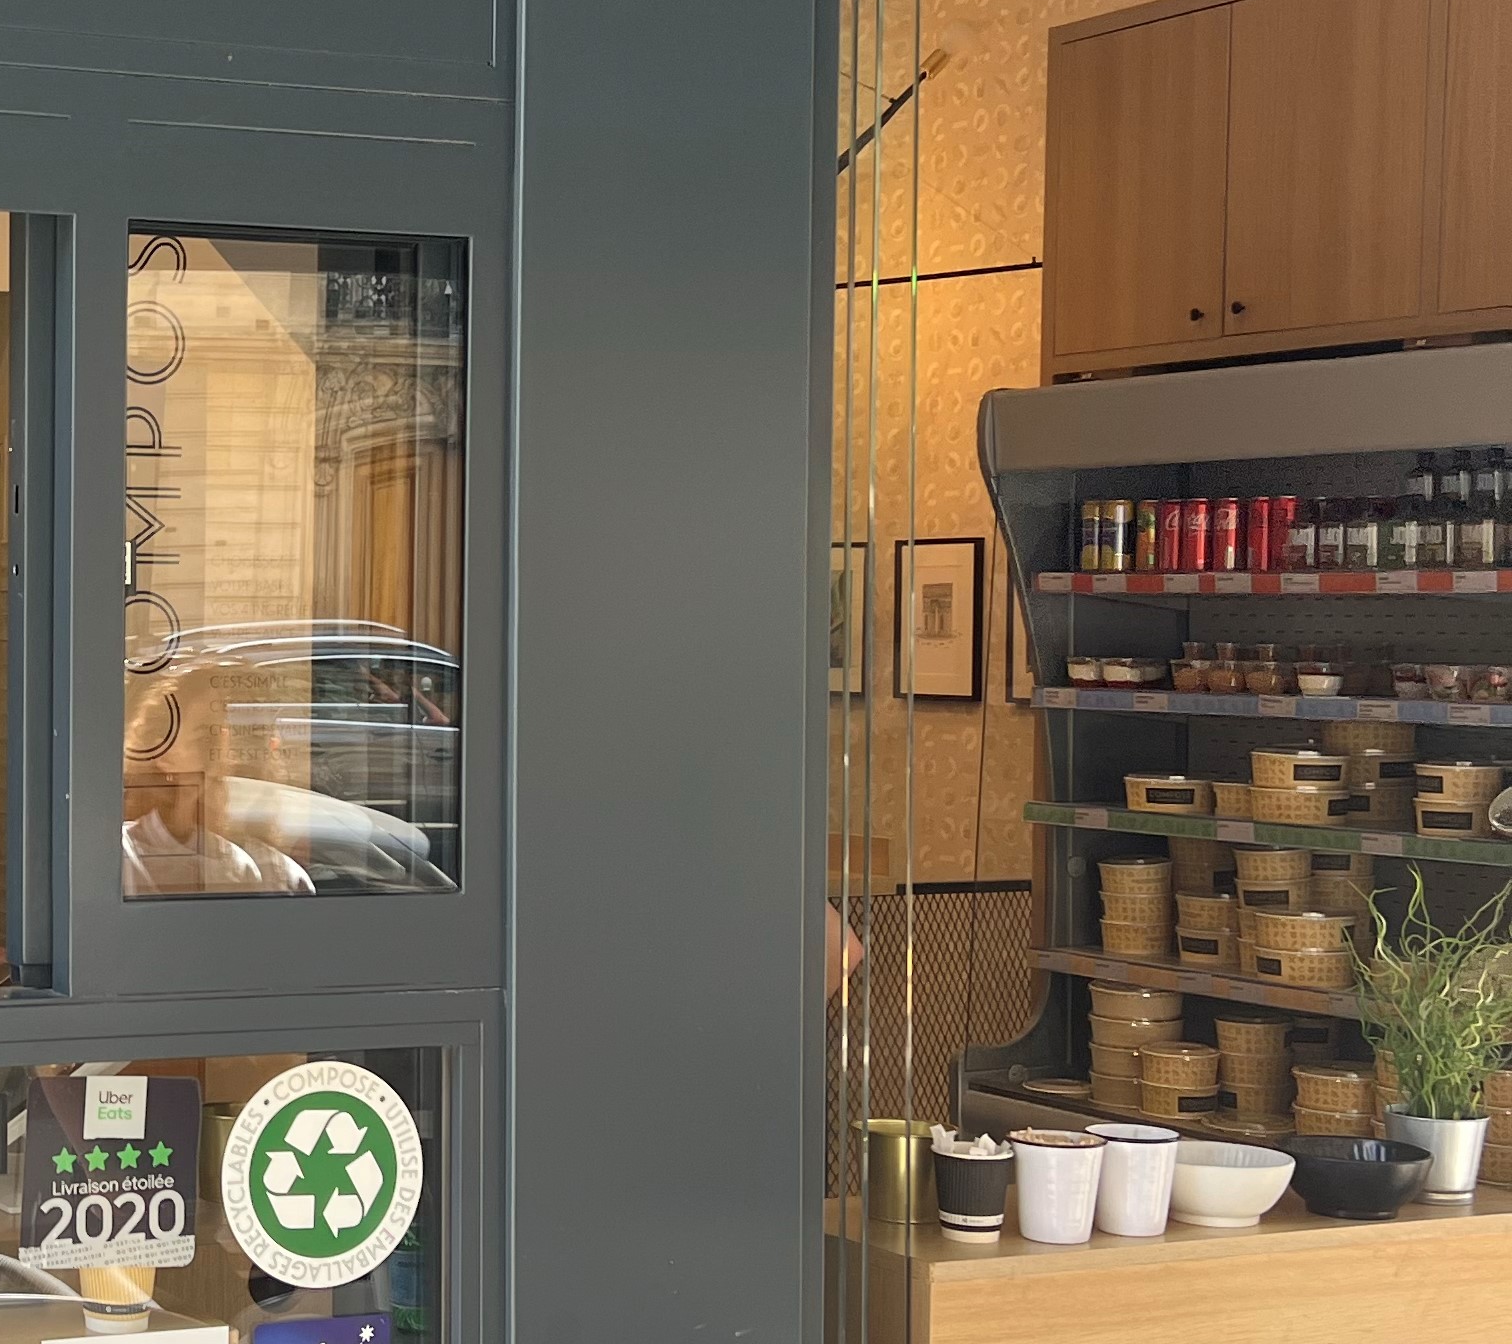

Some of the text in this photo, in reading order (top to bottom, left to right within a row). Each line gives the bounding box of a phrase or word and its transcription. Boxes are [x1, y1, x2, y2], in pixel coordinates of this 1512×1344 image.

[98, 1090, 133, 1104] Uber
[98, 1106, 132, 1120] Eats
[52, 1174, 175, 1196] Livraison étoilée
[227, 1067, 419, 1282] COMPOSE UTILISE DES EMBALLAGES RECYCLABLES
[40, 1189, 186, 1245] 2020
